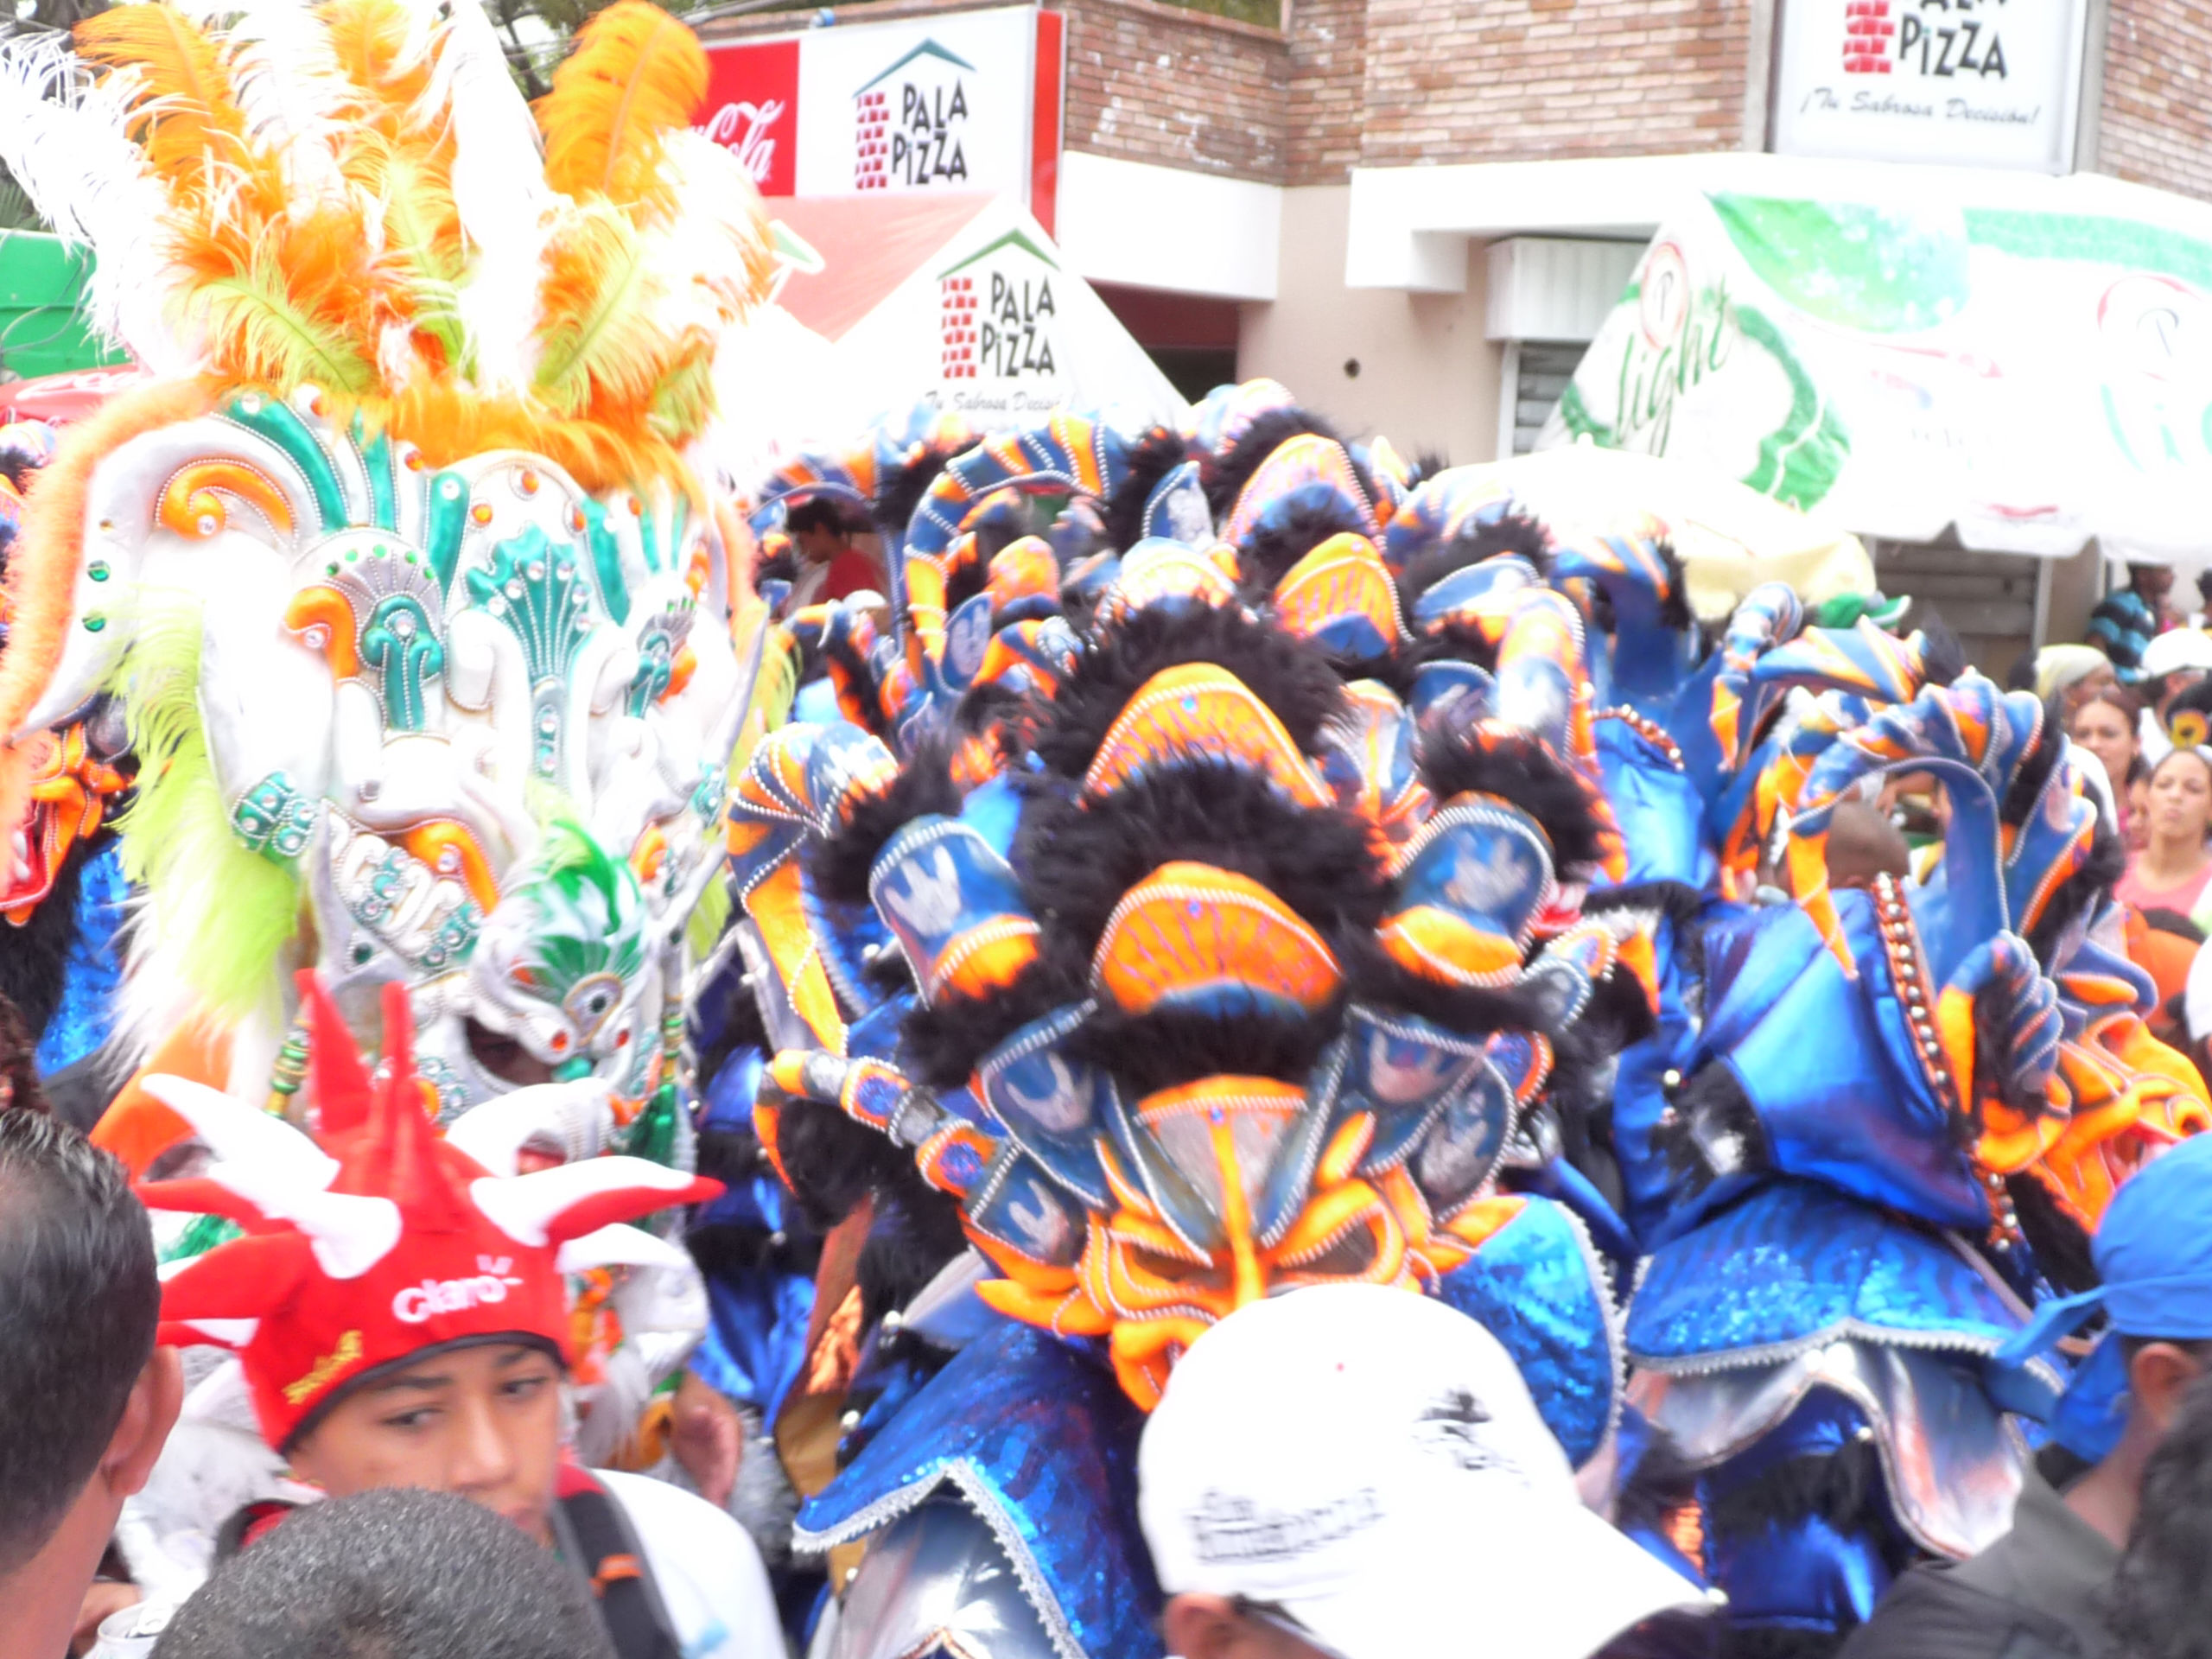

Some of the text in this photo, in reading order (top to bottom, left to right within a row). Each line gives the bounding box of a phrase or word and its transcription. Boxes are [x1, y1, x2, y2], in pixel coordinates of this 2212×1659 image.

[902, 79, 968, 135] PALA
[1851, 91, 1933, 117] Sabrosa
[991, 270, 1055, 326] PALA
[953, 391, 1007, 411] Sabrosa
